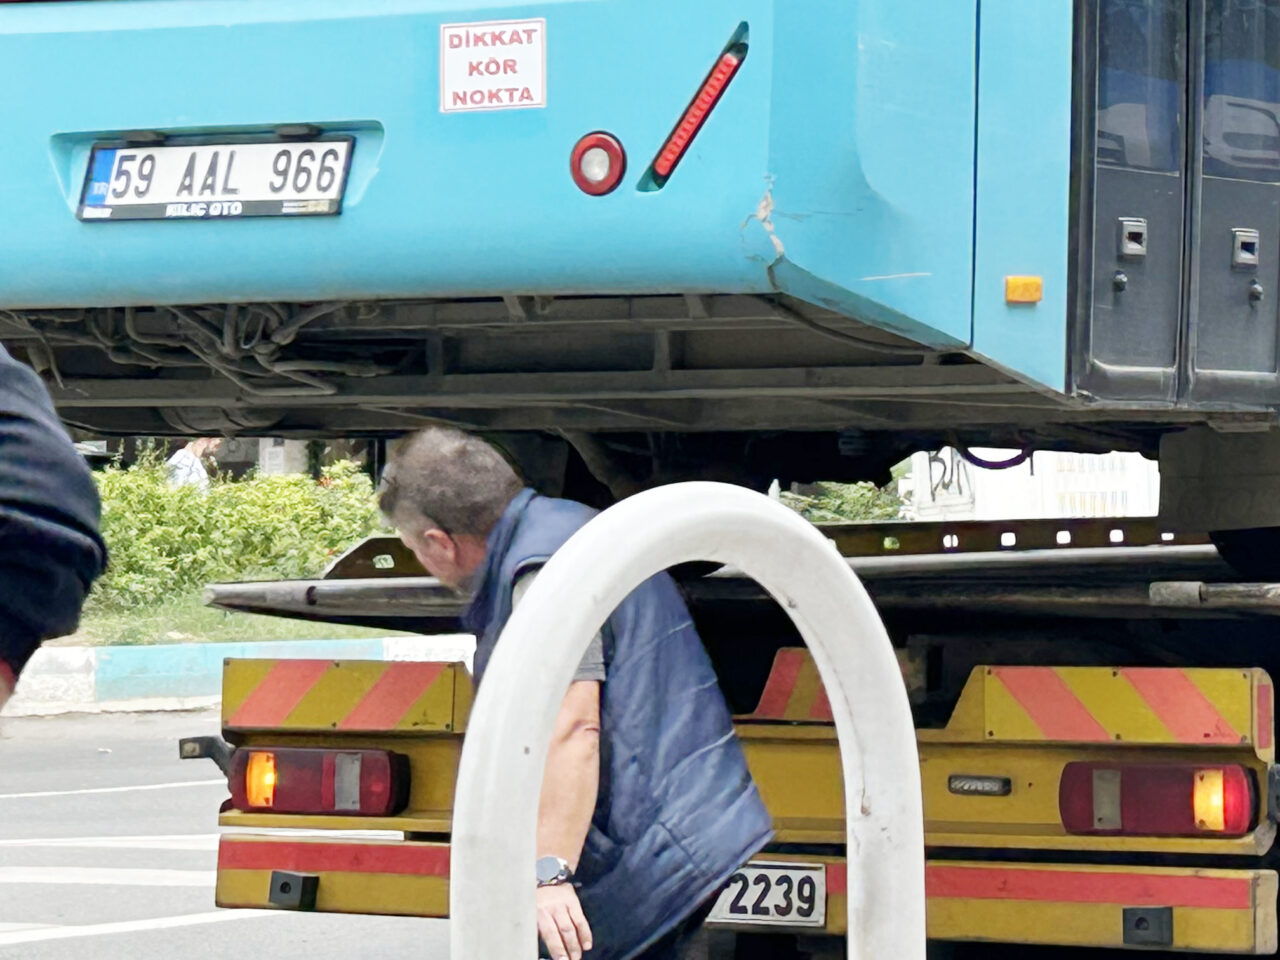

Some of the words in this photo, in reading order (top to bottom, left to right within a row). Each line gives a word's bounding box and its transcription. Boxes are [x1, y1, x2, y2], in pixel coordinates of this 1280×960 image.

[468, 57, 518, 77] KÖR
[452, 87, 534, 106] NOKTA
[111, 154, 157, 199] 59
[176, 150, 240, 197] AAL
[268, 147, 340, 195] 966
[208, 200, 243, 216] OTO
